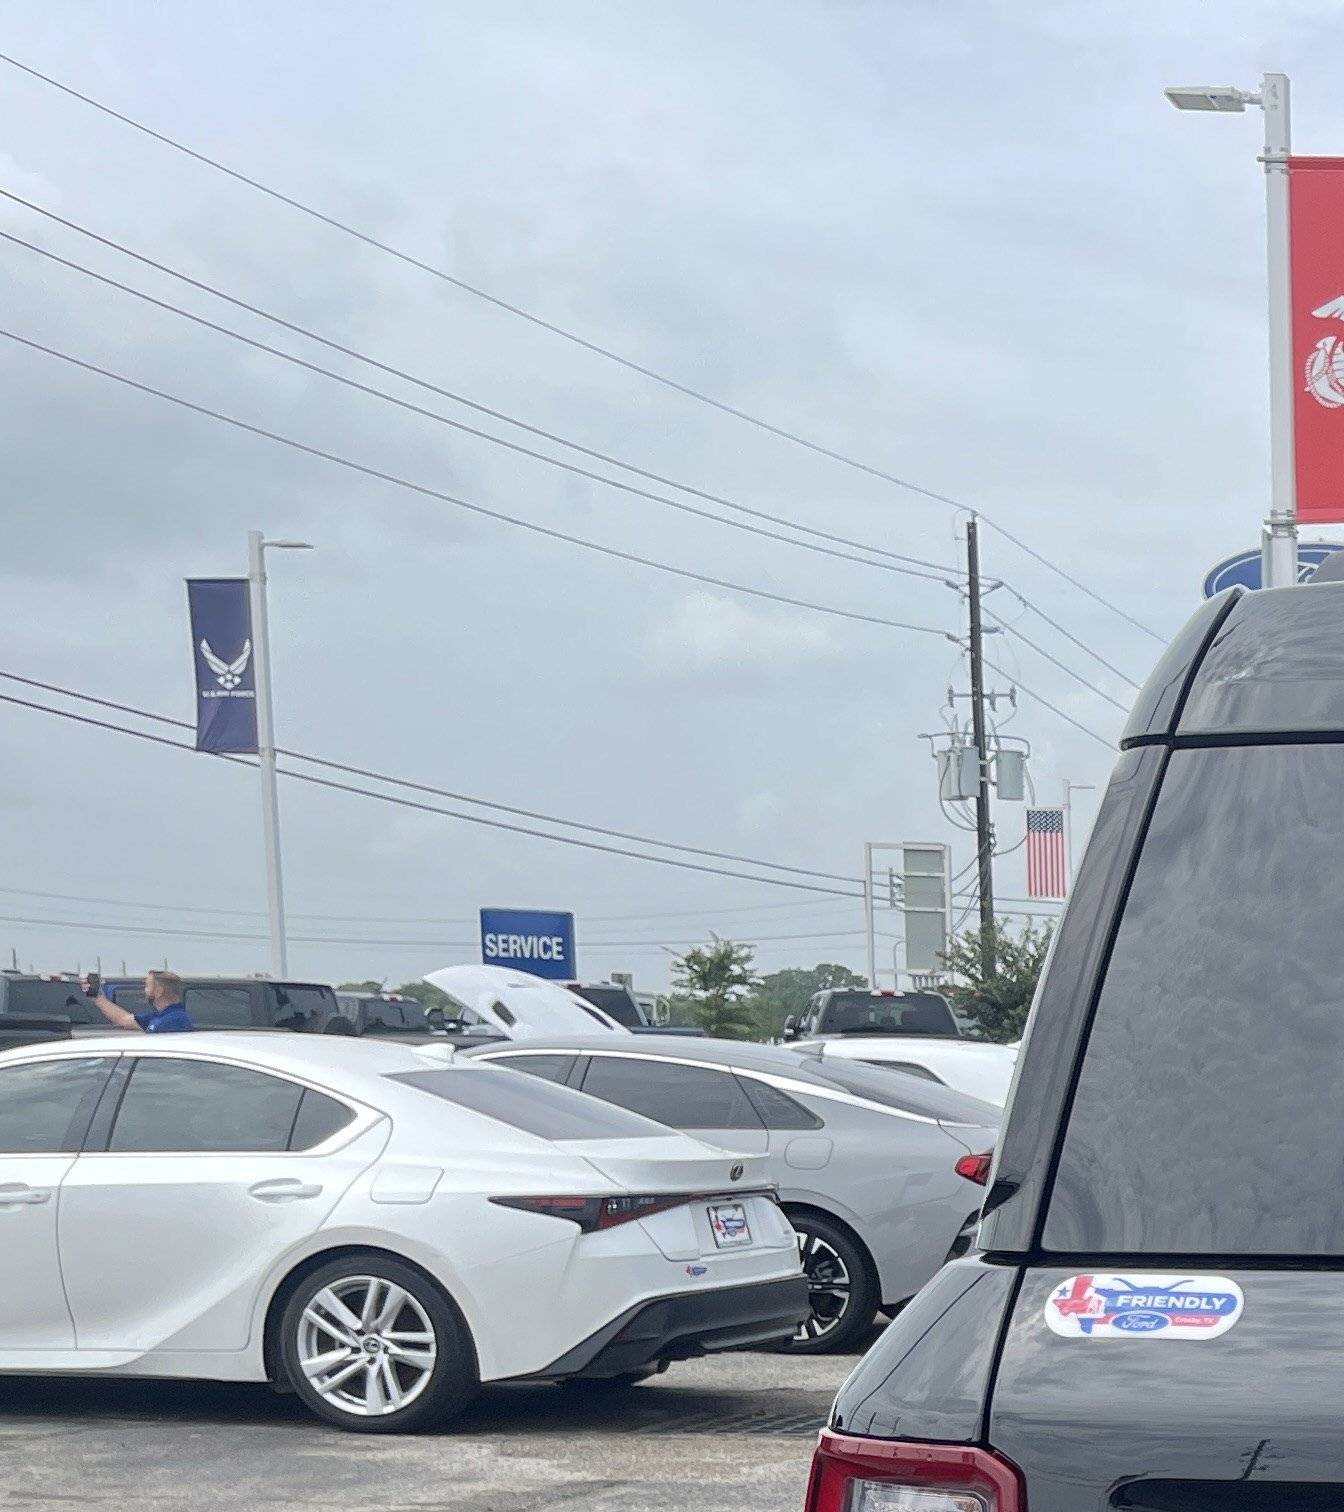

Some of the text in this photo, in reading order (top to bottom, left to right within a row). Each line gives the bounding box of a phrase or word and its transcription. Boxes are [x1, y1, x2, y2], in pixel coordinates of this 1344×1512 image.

[484, 933, 565, 961] SERVICE
[1116, 1295, 1227, 1310] FRIENDLY
[1121, 1314, 1160, 1331] Ford
